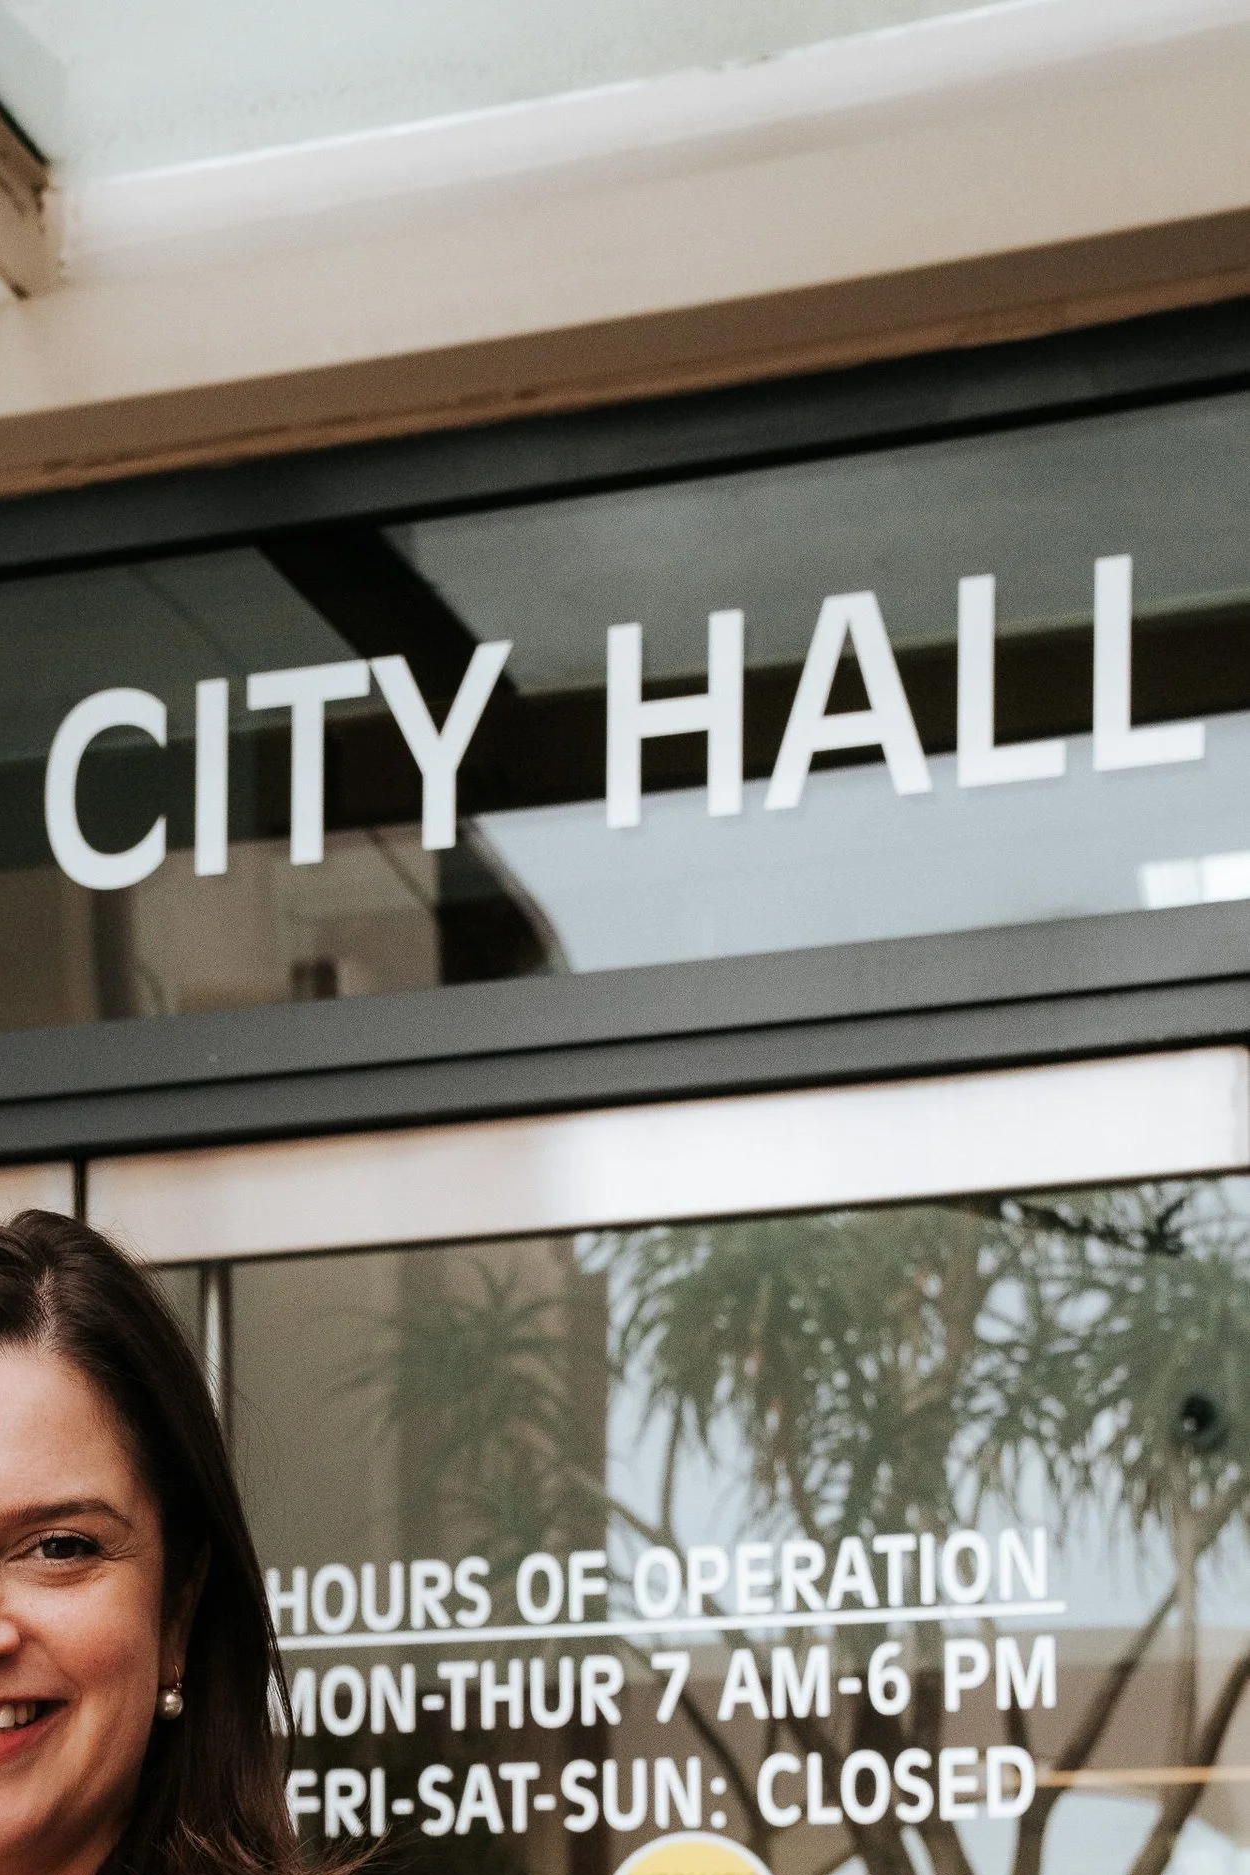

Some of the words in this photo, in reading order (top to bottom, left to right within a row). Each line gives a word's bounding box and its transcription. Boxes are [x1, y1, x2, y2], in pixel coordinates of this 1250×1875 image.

[44, 638, 514, 891] CITY
[604, 553, 1207, 831] HALL
[264, 1556, 493, 1636] HOURS
[515, 1548, 610, 1626] OF
[631, 1525, 1050, 1622] OPERATION
[266, 1655, 626, 1736] MON-THUR
[649, 1649, 692, 1724] 7
[716, 1642, 913, 1722] AM-6
[941, 1633, 1058, 1713] PM
[285, 1755, 728, 1839] FRI-SAT-SUN:
[756, 1743, 1039, 1828] CLOSED
